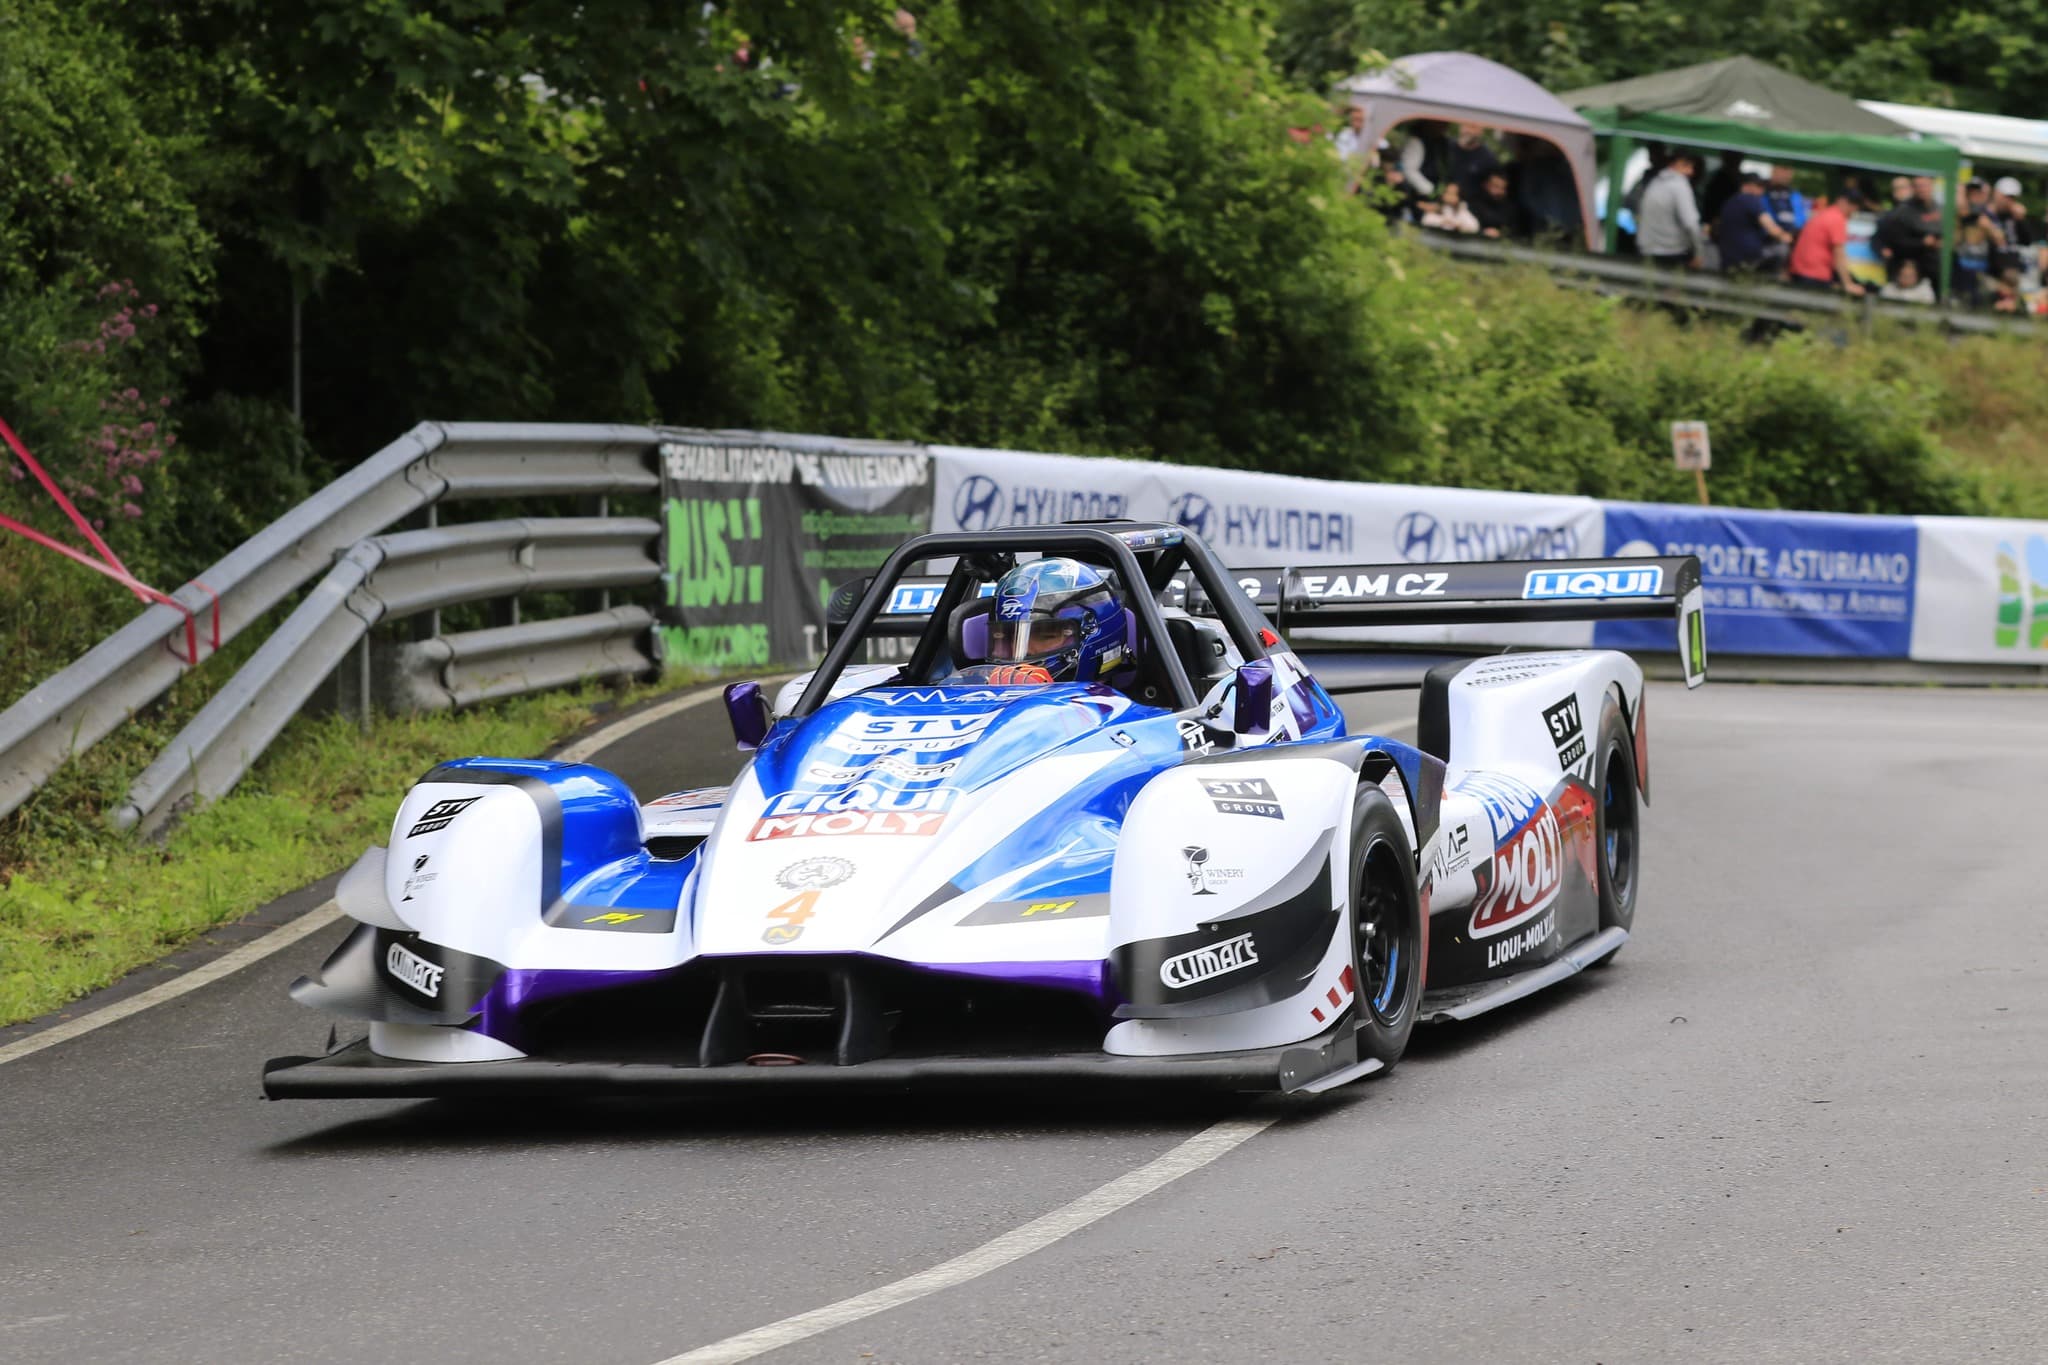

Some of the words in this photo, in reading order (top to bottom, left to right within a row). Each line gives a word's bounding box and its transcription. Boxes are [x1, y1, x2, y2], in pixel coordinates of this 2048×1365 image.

[1012, 487, 1129, 525] HYUNDAI
[1225, 504, 1353, 552] HYUNDAI
[1452, 522, 1579, 560] HYUNDAI
[1775, 549, 1910, 584] ASTURIANO
[1277, 574, 1389, 597] EAM
[1395, 573, 1449, 596] CZ
[1533, 570, 1653, 596] LIQUI
[864, 718, 983, 735] STV
[1550, 702, 1578, 739] STV
[1561, 740, 1584, 766] GROUP
[769, 784, 952, 816] LIQUI
[1211, 781, 1265, 796] STV
[426, 800, 475, 816] STV
[1221, 803, 1276, 815] GROUP
[756, 811, 945, 840] MOLY
[1206, 868, 1245, 878] WINERY
[1481, 809, 1559, 921] MOLY
[766, 890, 821, 925] 4
